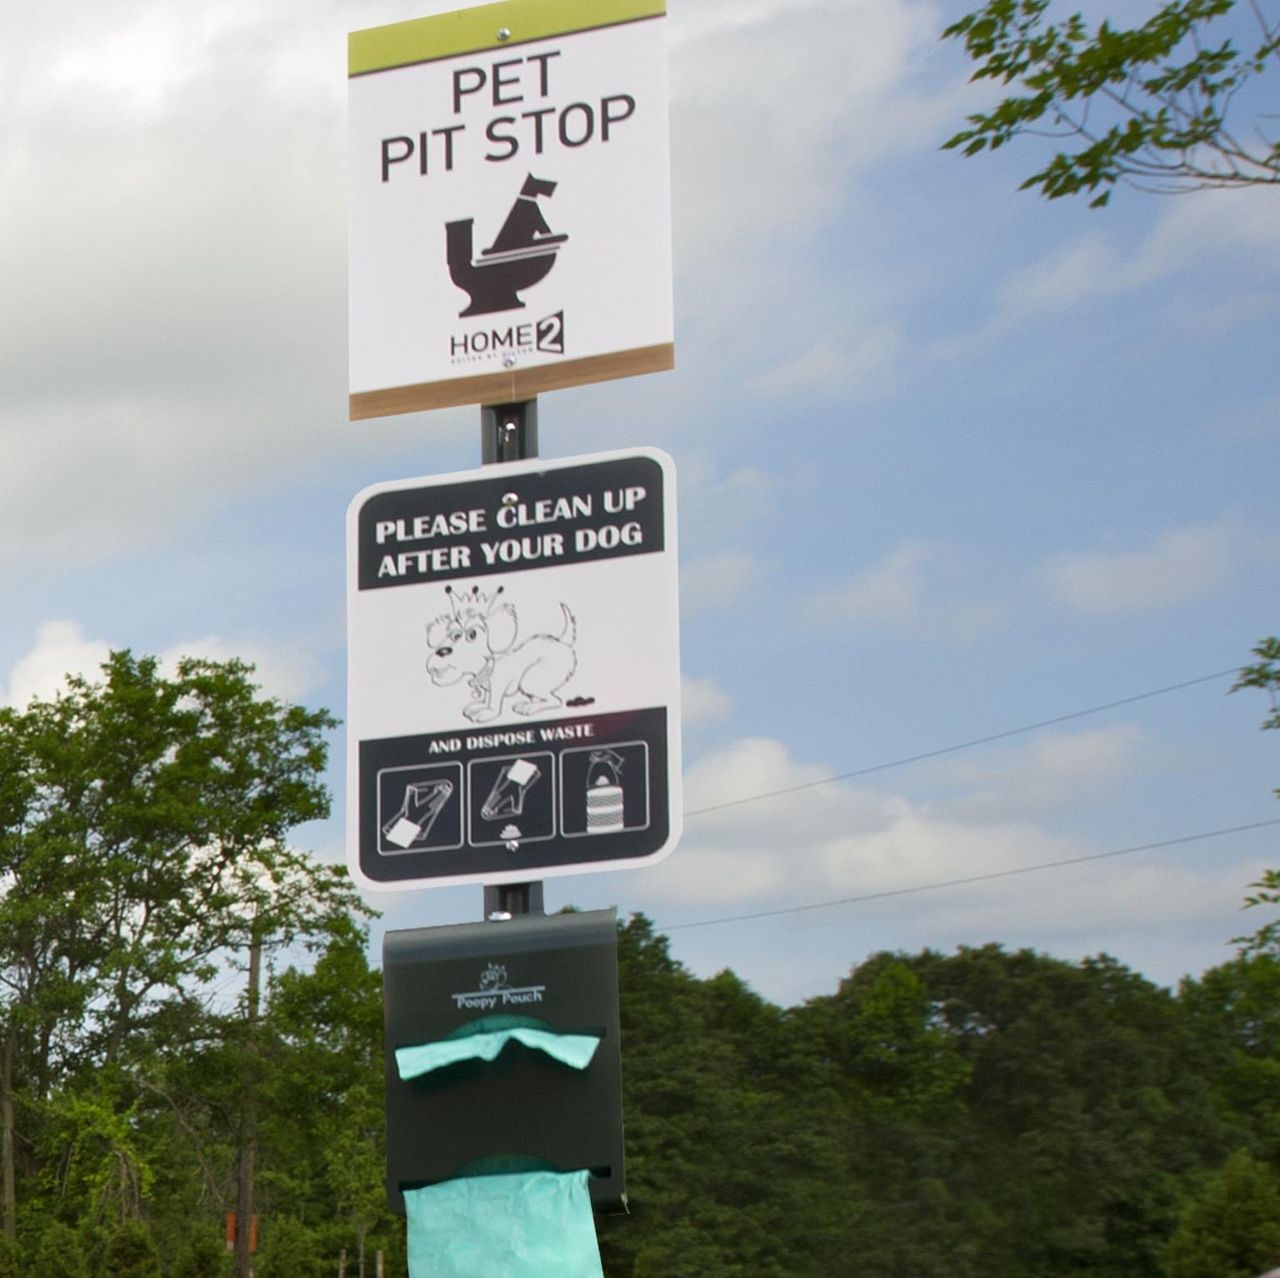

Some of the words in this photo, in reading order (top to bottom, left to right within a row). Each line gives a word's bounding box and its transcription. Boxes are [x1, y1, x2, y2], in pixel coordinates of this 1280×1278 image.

[452, 50, 562, 114] PET
[381, 124, 465, 182] PIT
[485, 94, 636, 162] STOP
[375, 508, 487, 545] PLEASE
[496, 493, 593, 530] CLEAN
[603, 486, 646, 514] UP
[378, 545, 471, 578] AFTER
[481, 533, 564, 566] YOUR
[575, 521, 643, 553] DOG
[428, 739, 462, 755] AND
[466, 729, 536, 751] DISPOSE
[540, 723, 595, 742] WASTE
[456, 996, 498, 1010] Poopy
[502, 990, 543, 1005] Pouch
